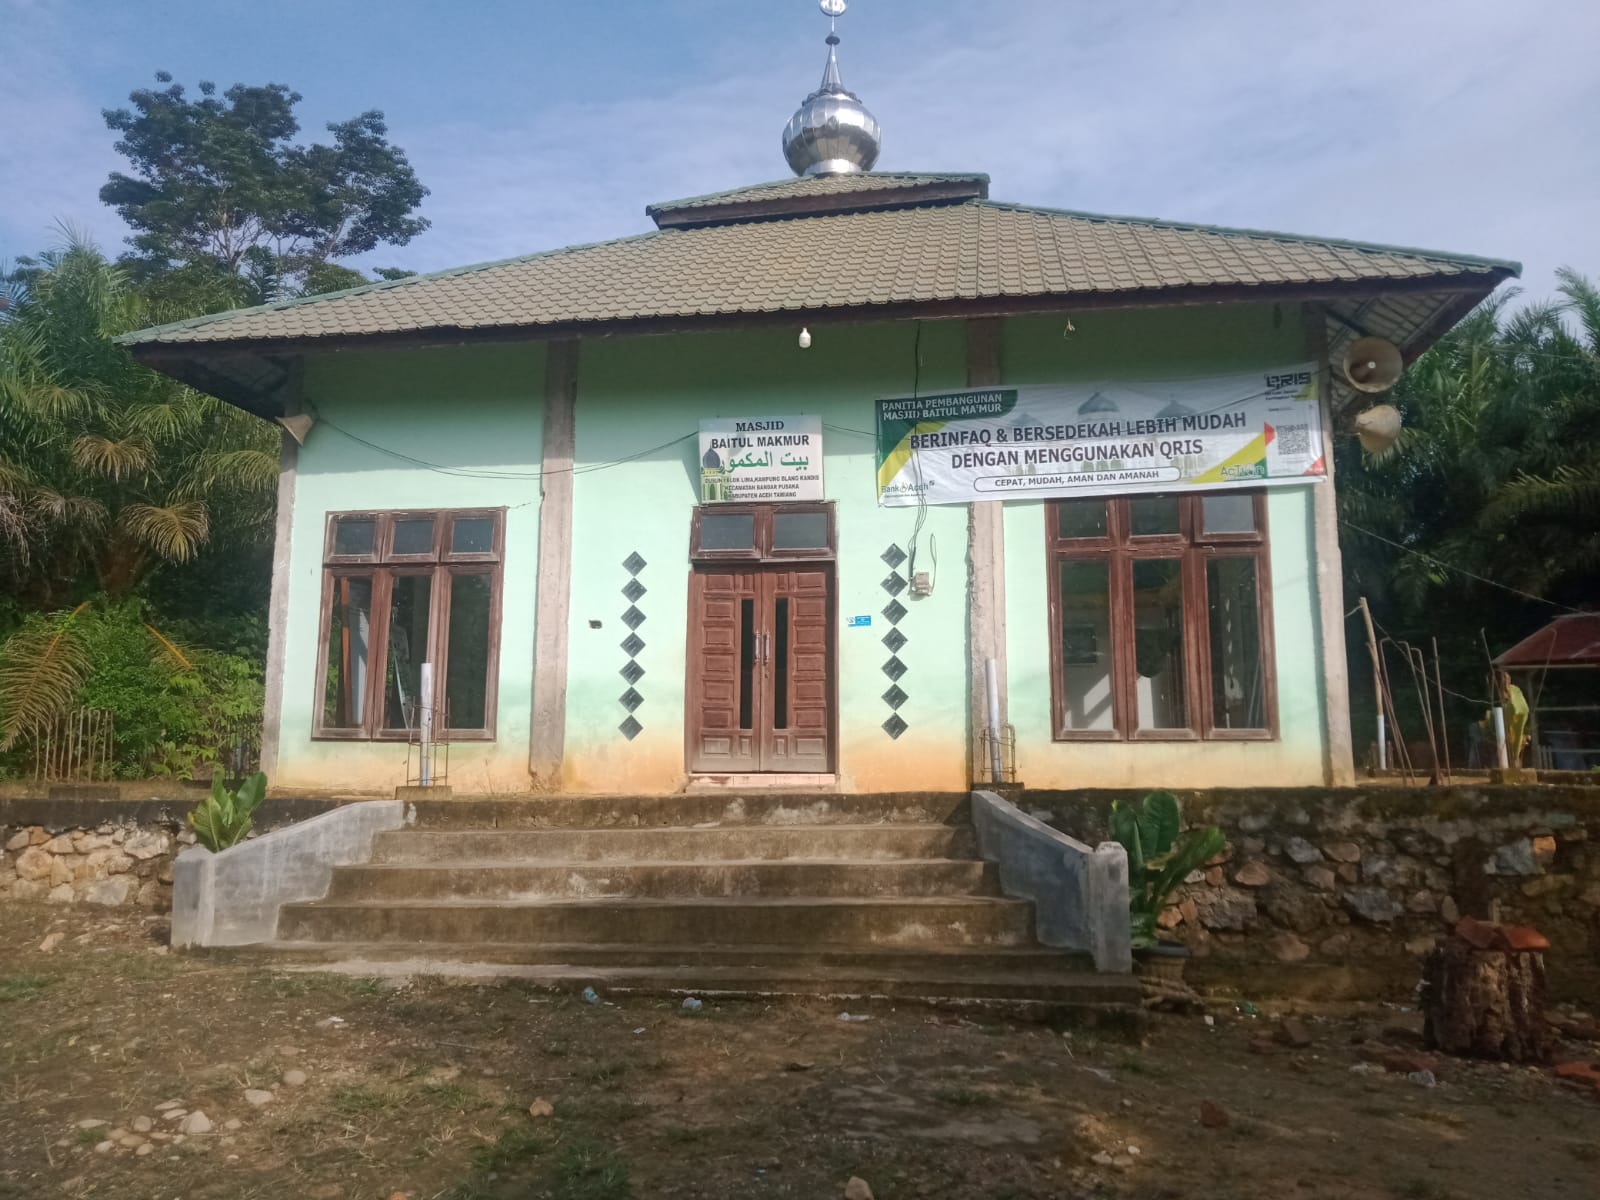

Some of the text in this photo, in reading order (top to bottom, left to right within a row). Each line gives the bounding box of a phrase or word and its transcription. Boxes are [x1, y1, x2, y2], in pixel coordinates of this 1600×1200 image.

[1266, 372, 1311, 389] QRIS
[882, 394, 1002, 411] PANITIA PEMBANGUNAN
[883, 403, 1002, 421] MASJID BAITUL MA'MUR
[736, 420, 784, 432] MASJID
[910, 412, 1246, 449] BERINFAQ & BERSEDEKAH LEBIH MUDAH
[711, 435, 810, 449] BAITUL MAKMUR
[952, 439, 1203, 469] DENGAN MENGGUNAKAN QRIS
[995, 470, 1159, 487] CEPAT, MUDAH, AMAN DAN AMANAH
